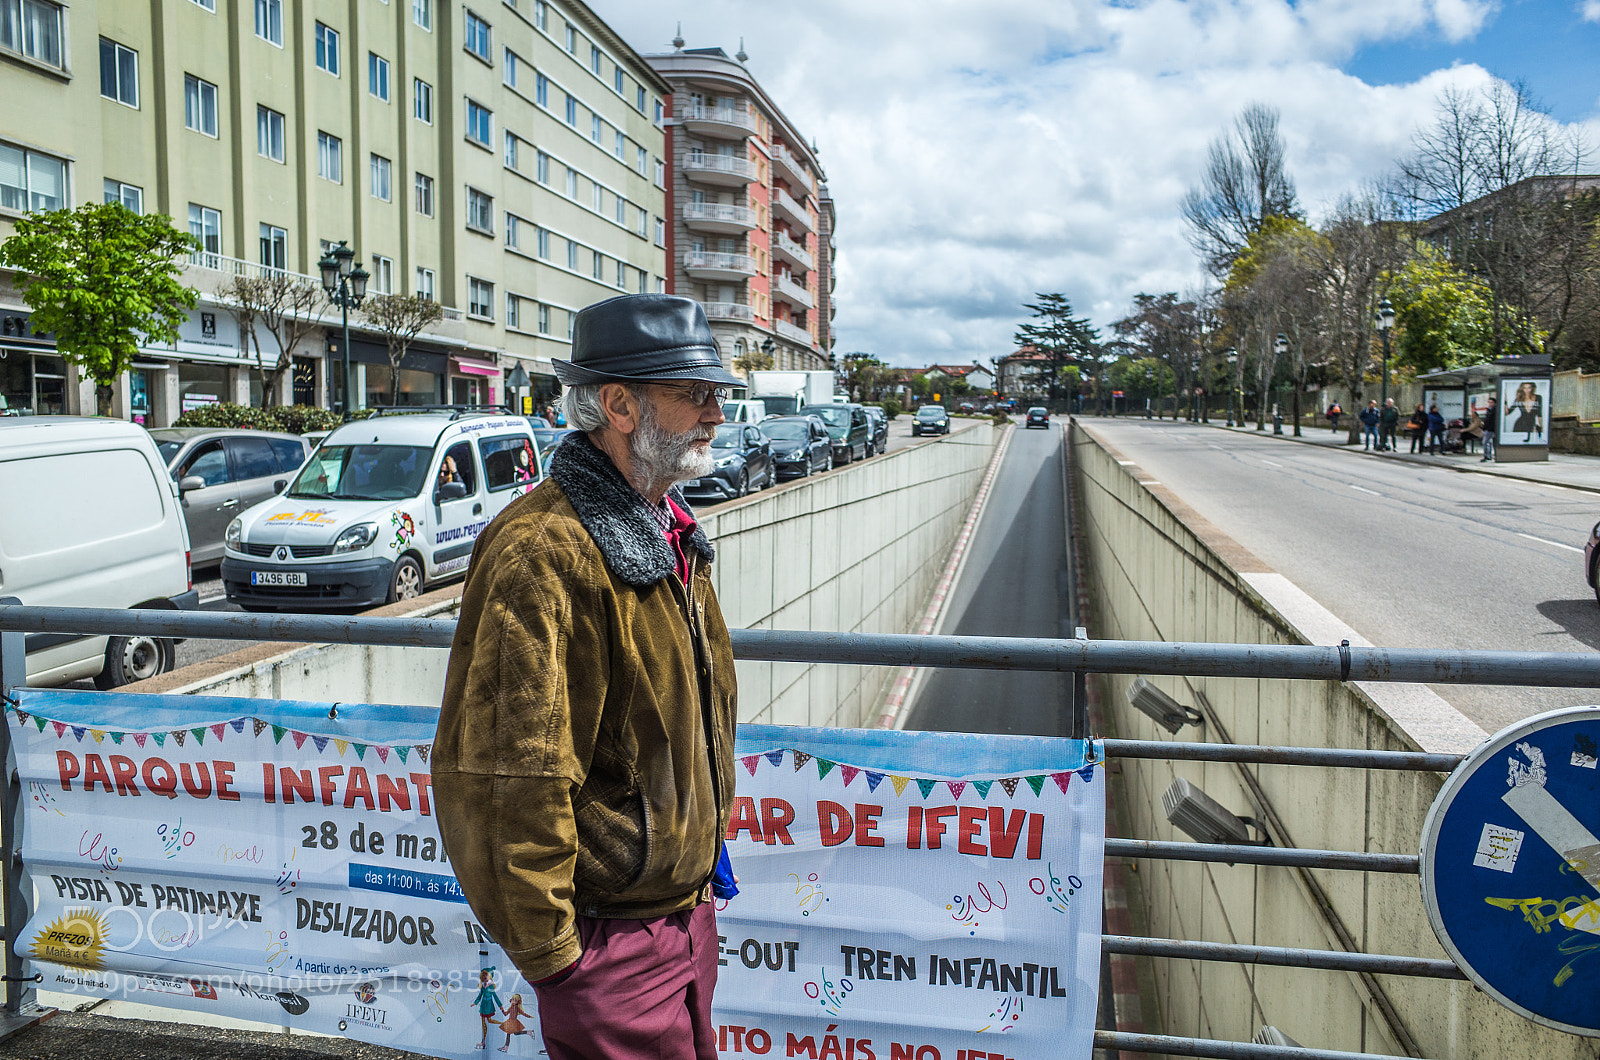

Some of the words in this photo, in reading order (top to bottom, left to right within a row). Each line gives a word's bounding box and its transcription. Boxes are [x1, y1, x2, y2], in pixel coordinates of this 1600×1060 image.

[258, 572, 283, 584] 3496
[286, 574, 305, 585] GBL
[56, 750, 241, 801] PARQUE
[301, 821, 339, 850] 28
[350, 822, 385, 855] de
[817, 800, 885, 847] DE
[907, 805, 1044, 860] IFEVI
[365, 870, 383, 885] das
[387, 873, 413, 889] 11:00
[415, 877, 424, 891] h.
[427, 879, 440, 893] ás
[50, 874, 112, 903] PISTA
[114, 881, 147, 907] DE
[152, 884, 263, 922] PATINAXE
[296, 898, 437, 946] DESLIZADOR
[48, 931, 95, 947] PREZOS:
[74, 951, 79, 959] 4
[82, 951, 89, 960] €
[295, 958, 303, 971] A
[304, 962, 331, 975] partir
[333, 964, 348, 975] de
[349, 965, 358, 975] 2
[56, 974, 76, 985] Aforo
[77, 977, 109, 989] Limitado
[841, 945, 917, 981] TREN
[929, 954, 1066, 999] INFANTIL
[346, 1004, 387, 1024] IFEVI
[711, 1025, 772, 1055] ITO
[786, 1024, 877, 1060] MÁIS
